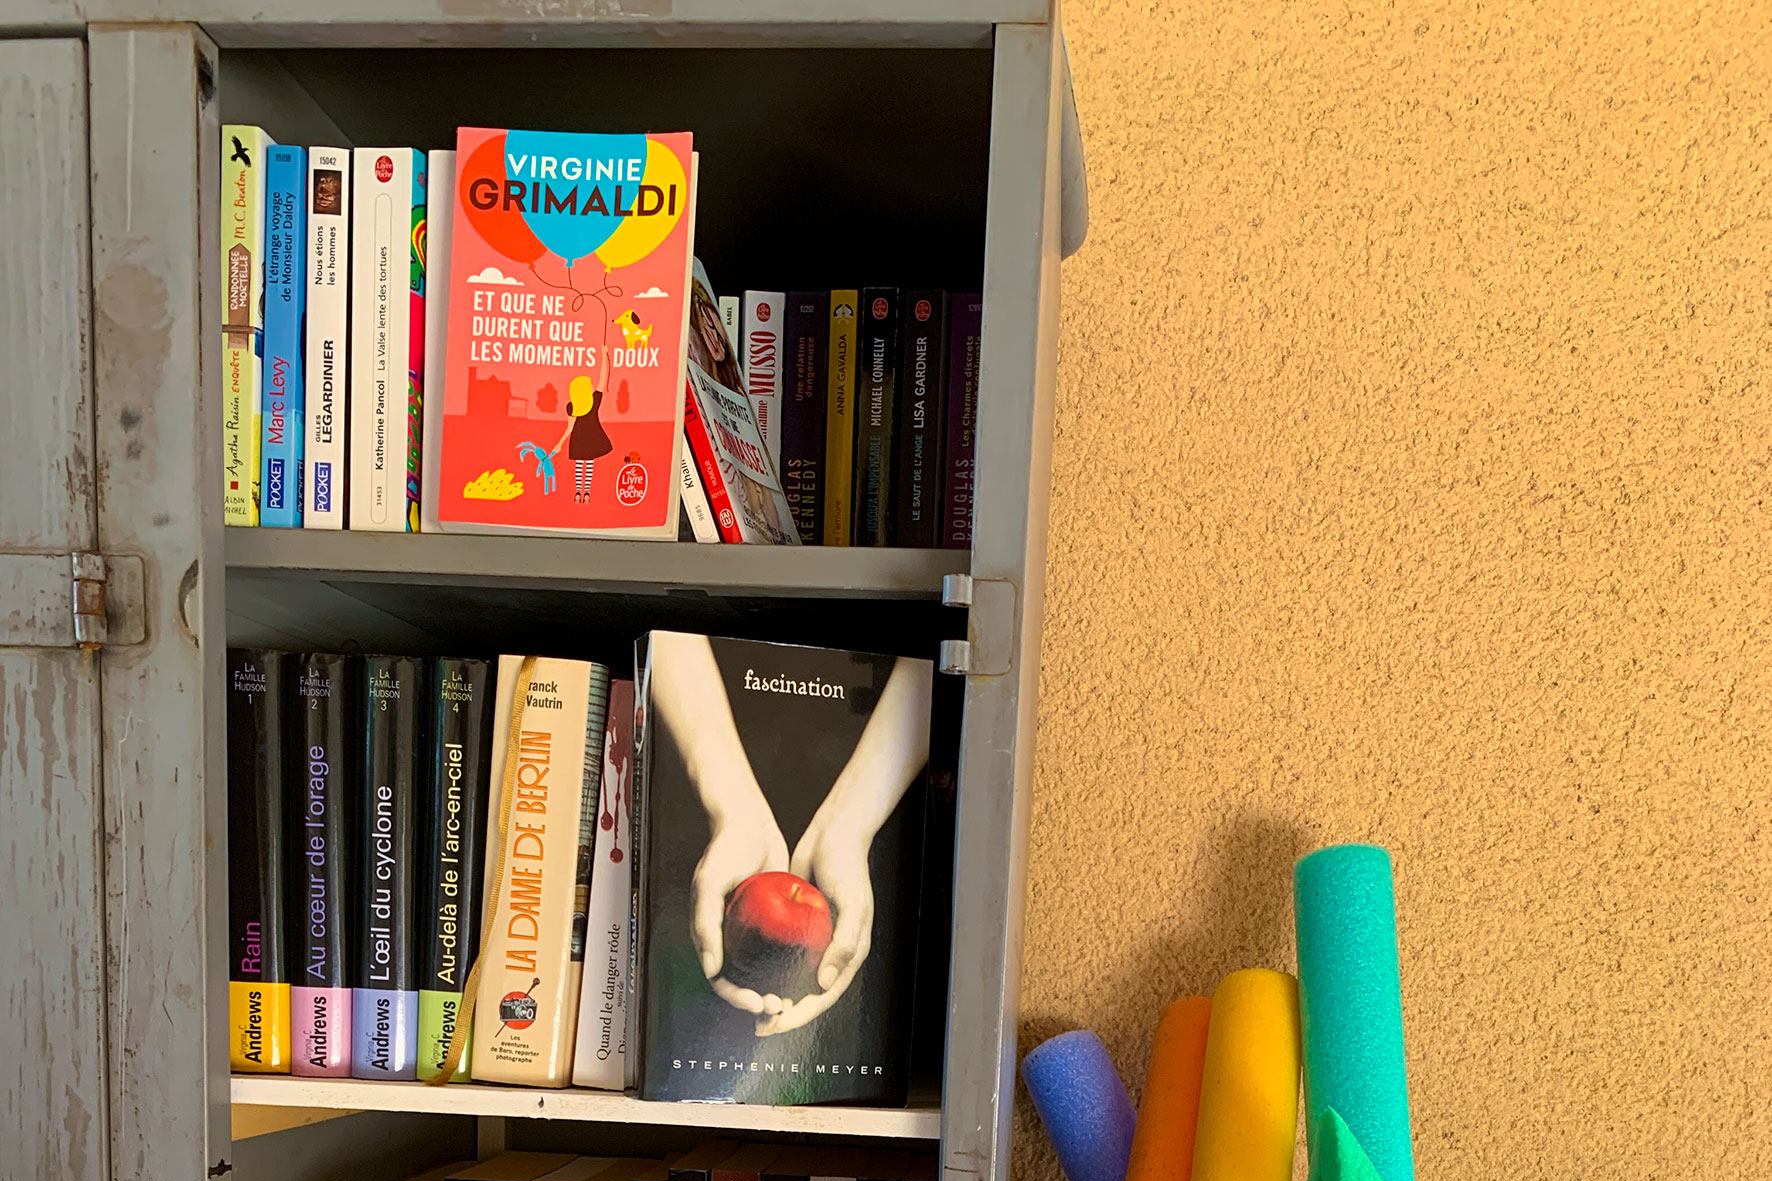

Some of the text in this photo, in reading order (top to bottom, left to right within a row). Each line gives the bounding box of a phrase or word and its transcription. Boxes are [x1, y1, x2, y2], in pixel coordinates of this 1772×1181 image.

[469, 177, 676, 216] GRIMALDI
[507, 154, 642, 182] VIRGINIE
[233, 169, 247, 239] M.C. Beaton
[269, 192, 282, 284] L'étrange voyage
[239, 255, 248, 307] MORTELLE
[281, 192, 295, 302] de Monsieur Daldry
[314, 226, 323, 285] Nous étions
[327, 226, 336, 286] les hommes
[472, 316, 584, 343] DURENT QUE
[474, 290, 565, 316] ET QUE NE
[375, 246, 388, 471] Katherine Pancol Valse lente des tortues
[471, 341, 659, 367] LES MOMENTS DOUX
[749, 331, 777, 398] MUSSO
[805, 336, 815, 398] dangereuse
[836, 334, 847, 416] ANNA GAVALDA
[870, 337, 885, 427] MICHAEL CONNELLY
[913, 336, 927, 429] LISA GARDNER
[226, 351, 242, 477] Agatha Raisin ENQUÊTE
[268, 356, 289, 445] Marc Levy
[322, 340, 334, 443] LEGARDINIER
[270, 458, 282, 508] POCKET
[317, 462, 329, 512] POCKET
[619, 488, 644, 500] Poche
[622, 474, 643, 485] Livre
[801, 458, 817, 541] KENNEDY
[912, 483, 921, 508] SAUT
[952, 458, 969, 541] DOUGLAS
[234, 682, 266, 692] HUDSON
[526, 695, 563, 710] Vautrin
[743, 669, 845, 700] fascination
[305, 745, 329, 980] Au cœur de l'orage
[369, 785, 396, 982] L'œil du cyclone
[437, 743, 463, 985] Au-delà de l'arc-en-ciel
[505, 730, 552, 973] LA DAME DE BERLIN
[241, 921, 261, 973] Rain
[596, 923, 621, 1061] Quand le danger rôde
[245, 991, 262, 1063] Andrews
[310, 996, 327, 1069] Andrews
[371, 998, 390, 1071] Andrews
[672, 1059, 883, 1075] STEPHENIE MEYER
